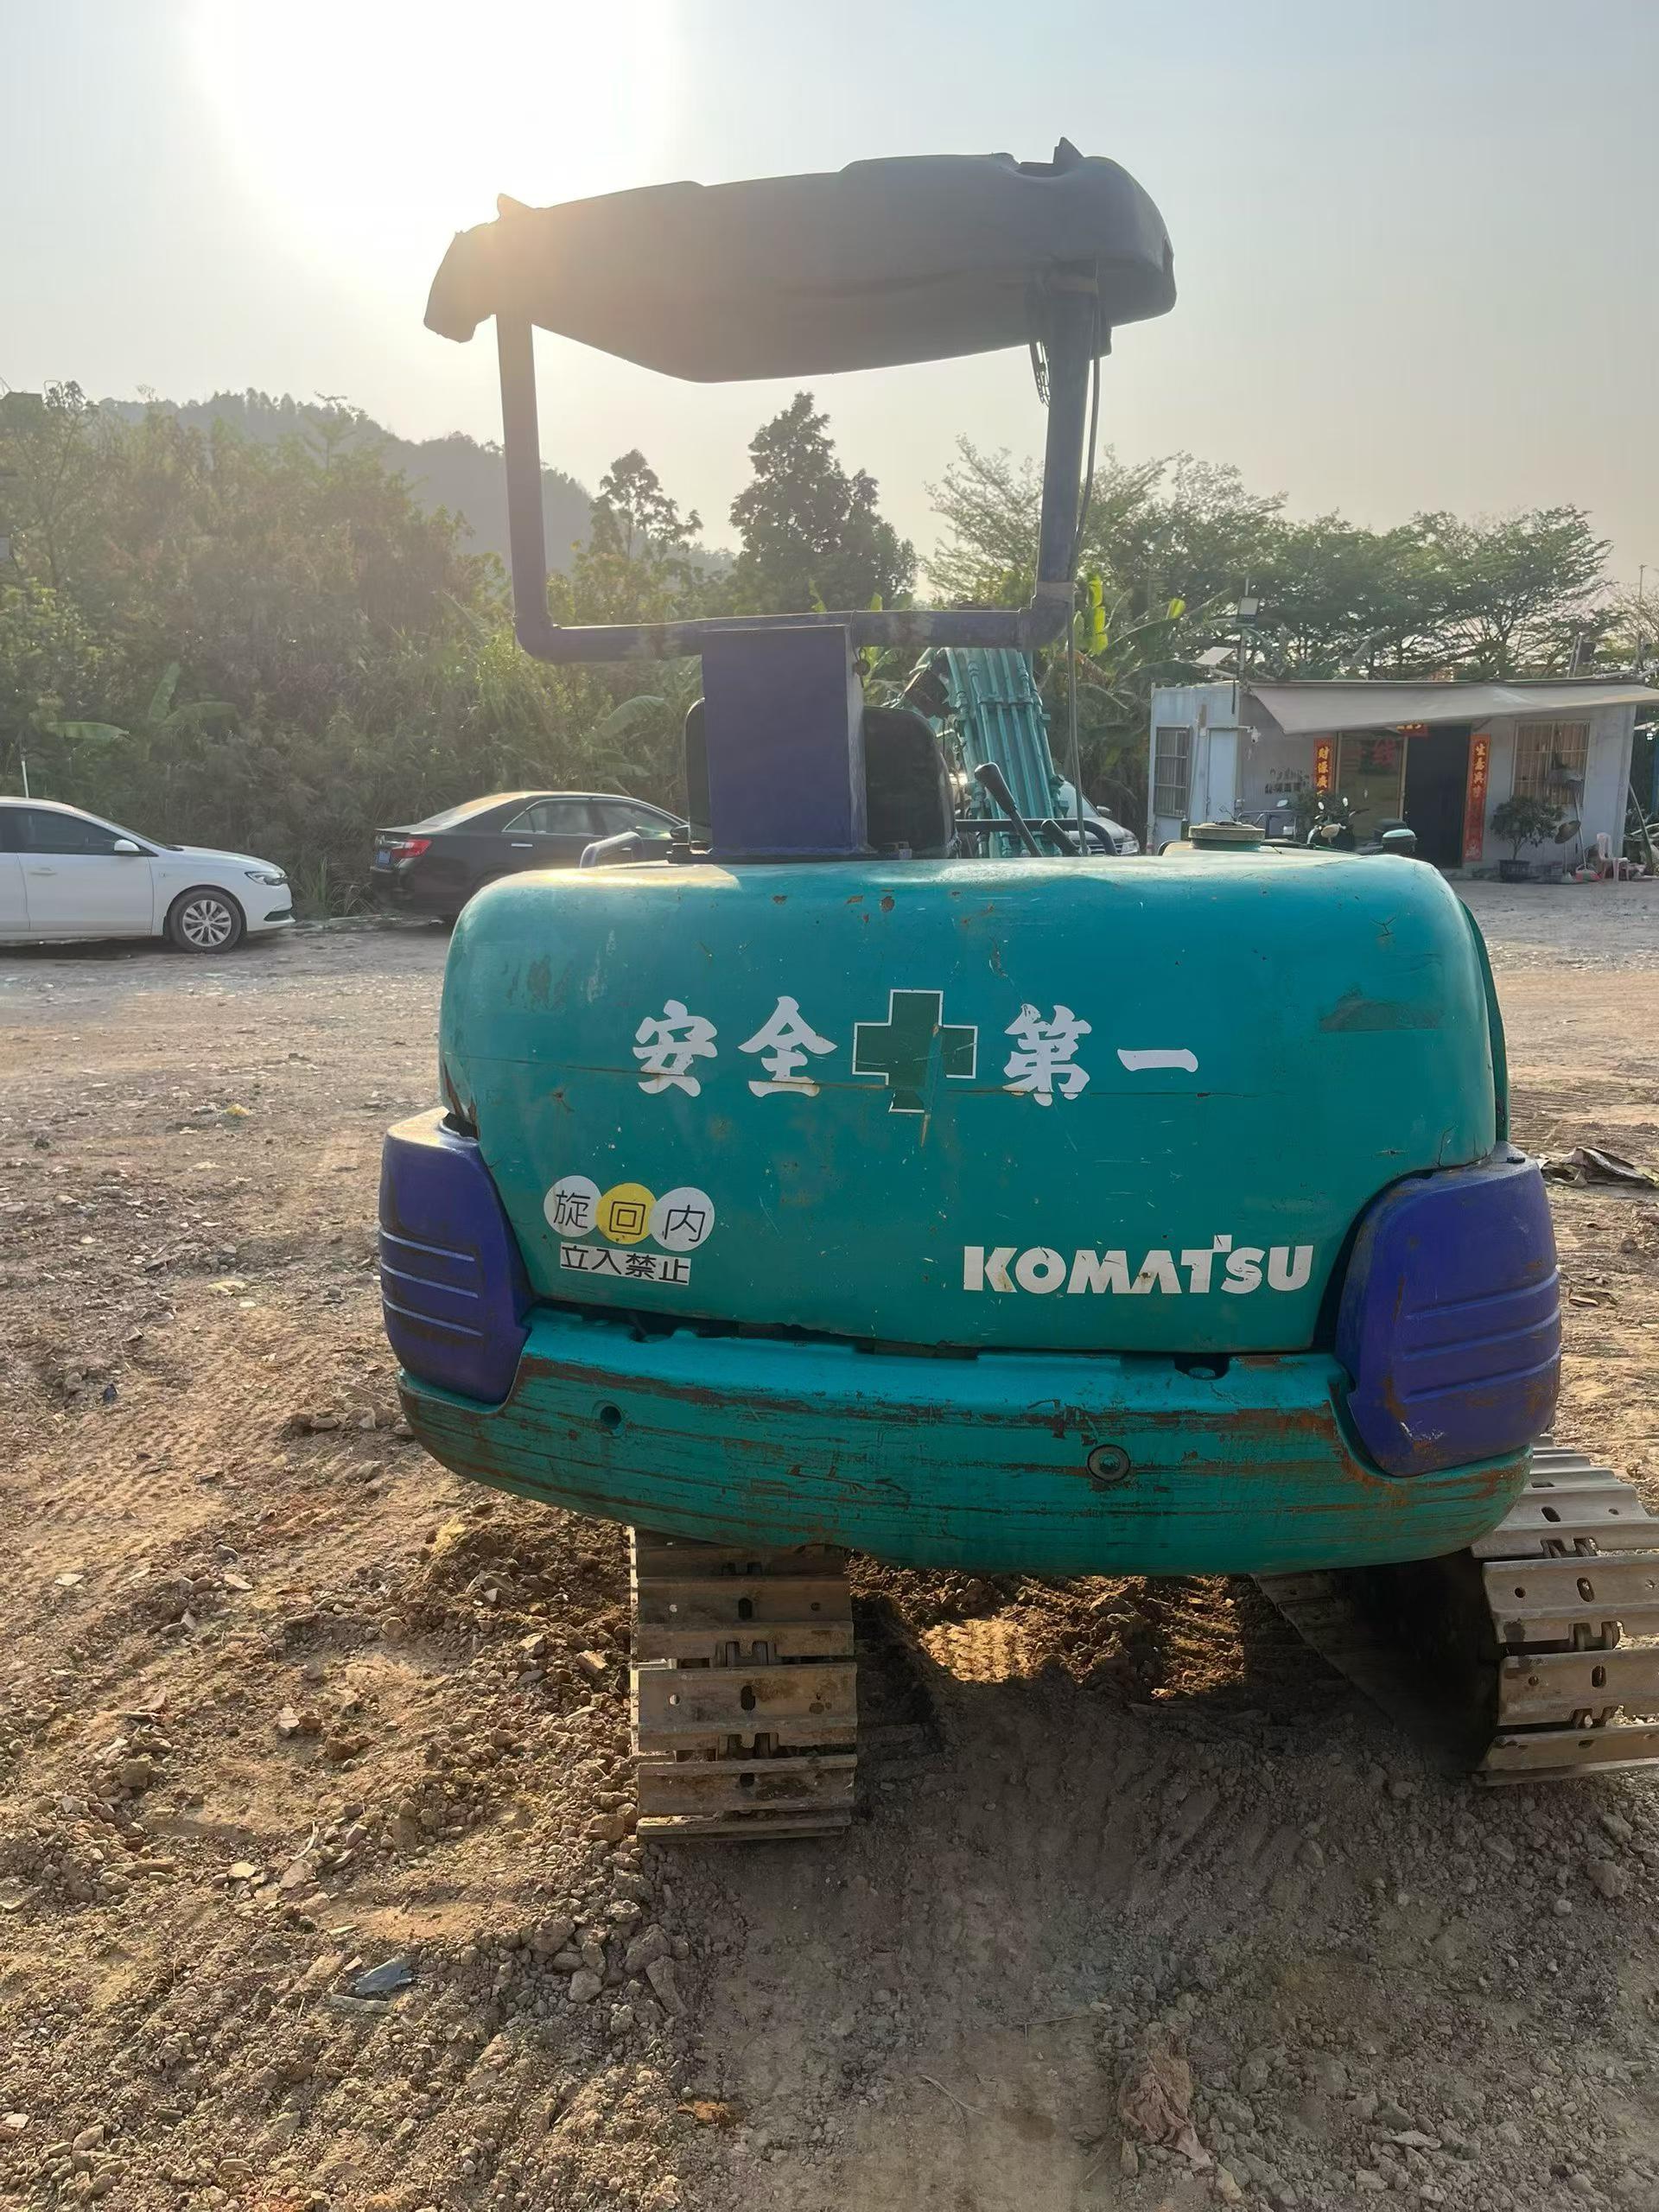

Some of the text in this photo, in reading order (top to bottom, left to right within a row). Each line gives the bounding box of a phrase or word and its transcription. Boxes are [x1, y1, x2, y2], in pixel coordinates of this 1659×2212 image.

[632, 995, 1198, 1106] 安全 第一
[553, 1190, 706, 1243] 旋回内
[560, 1245, 690, 1284] 立入禁止
[963, 1234, 1314, 1294] KOMATSU
